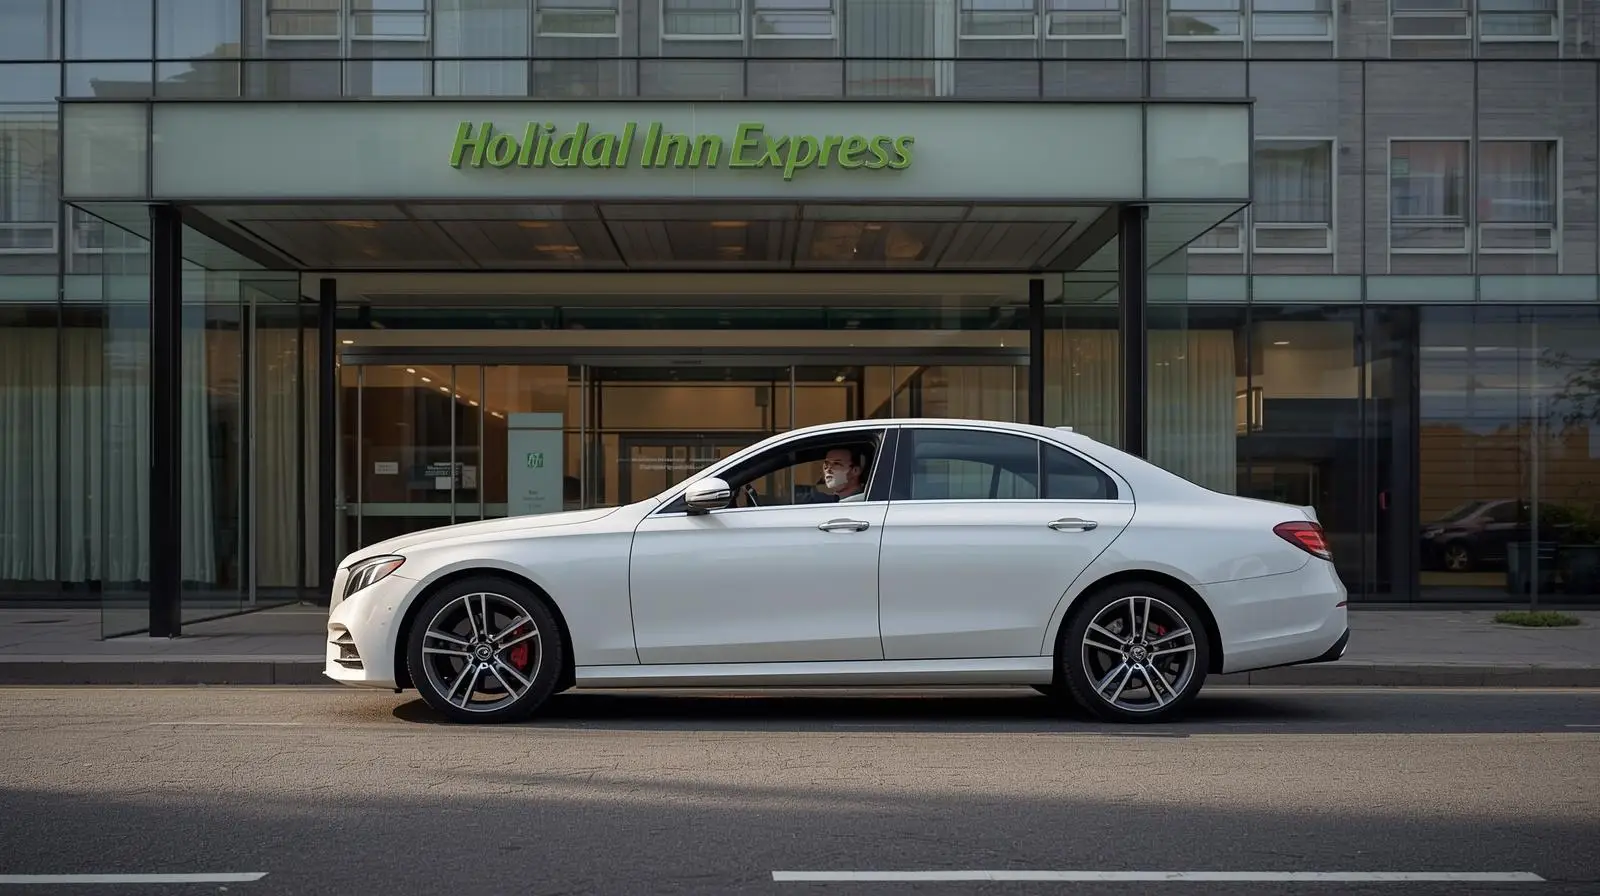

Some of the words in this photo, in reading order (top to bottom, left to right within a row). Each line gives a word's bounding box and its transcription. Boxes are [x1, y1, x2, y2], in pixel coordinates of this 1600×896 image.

[449, 121, 637, 169] Holidal
[640, 123, 723, 169] Inn
[729, 122, 915, 181] Express
